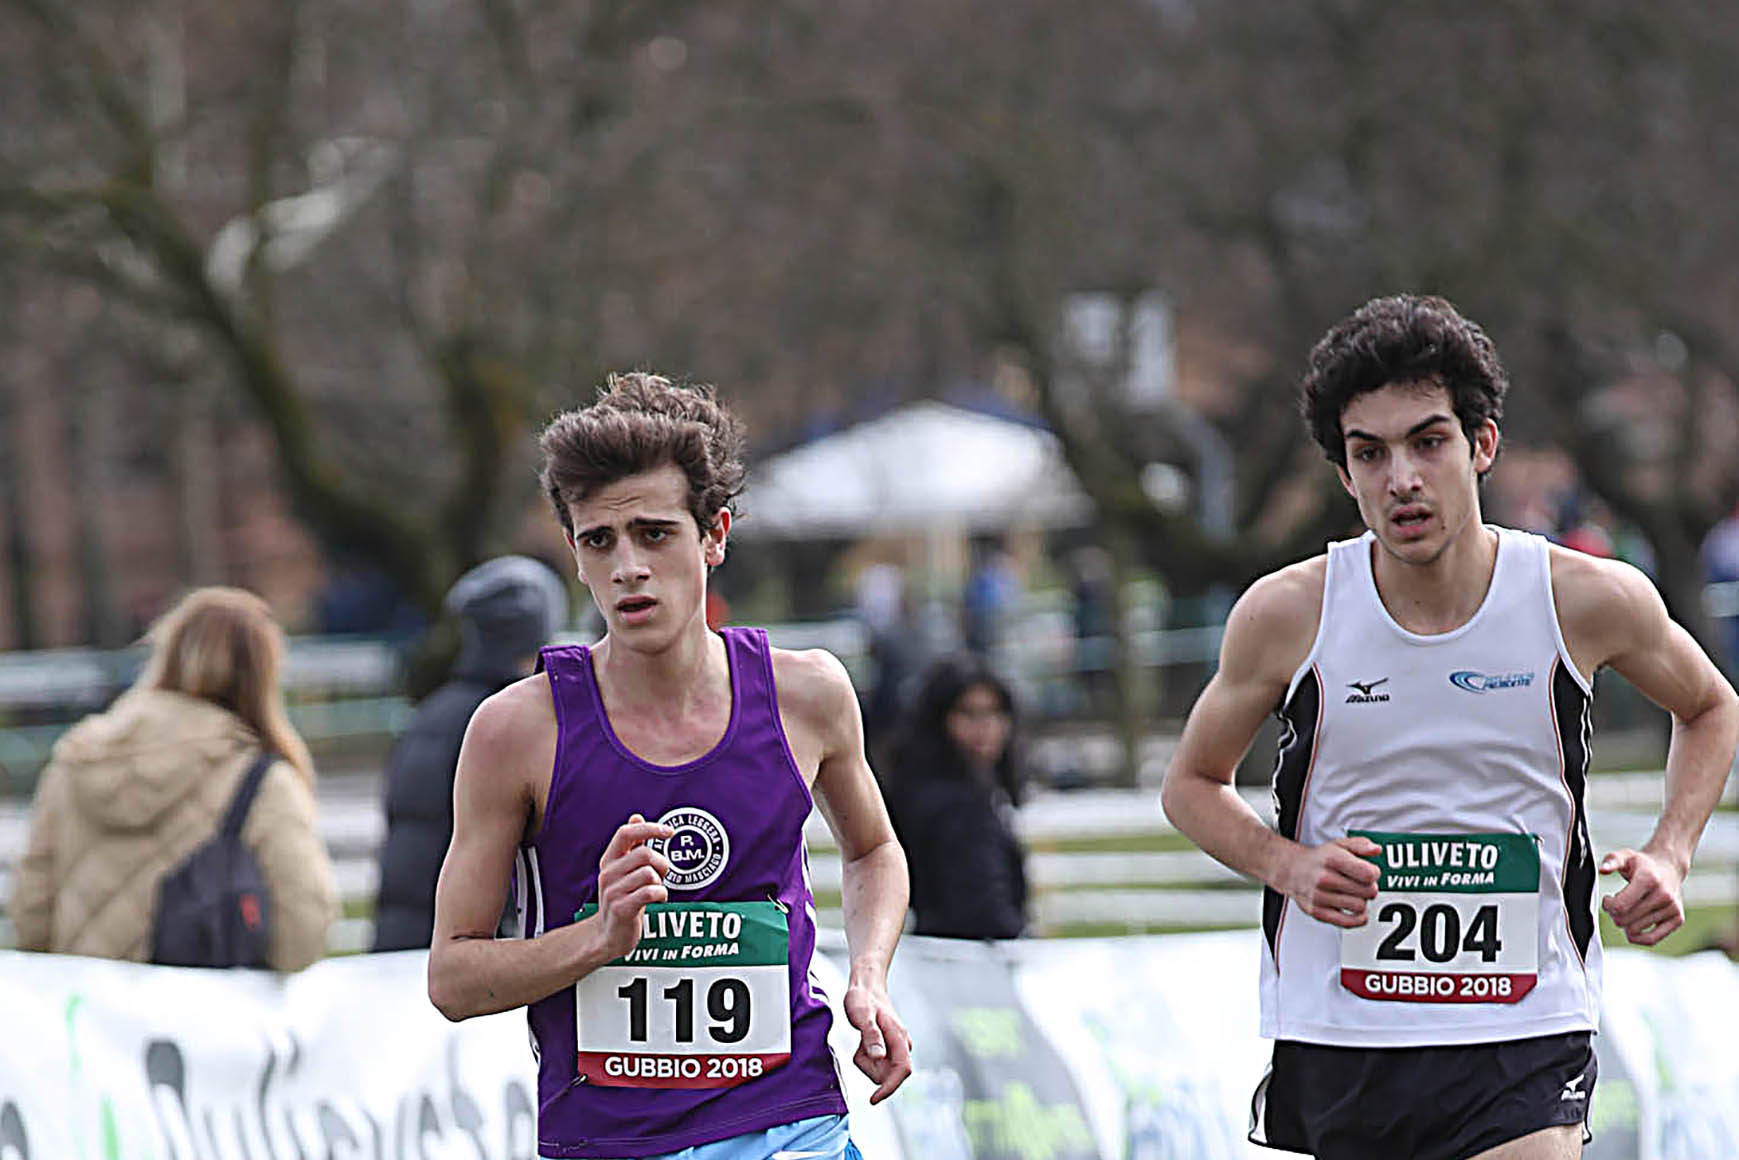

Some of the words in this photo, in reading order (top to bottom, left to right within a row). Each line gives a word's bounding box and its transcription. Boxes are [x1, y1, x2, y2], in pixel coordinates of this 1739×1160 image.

[1386, 841, 1499, 870] ULIVETO
[1386, 875, 1419, 888] VIVI
[1440, 872, 1494, 887] FORMA
[642, 911, 742, 939] LIVETO
[1375, 902, 1502, 963] 204
[680, 942, 739, 960] FORMA
[1364, 973, 1455, 996] GUBBIO
[1459, 976, 1512, 997] 2018
[618, 977, 751, 1044] 119
[604, 1056, 701, 1079] GUBBIO
[706, 1057, 764, 1079] 2018
